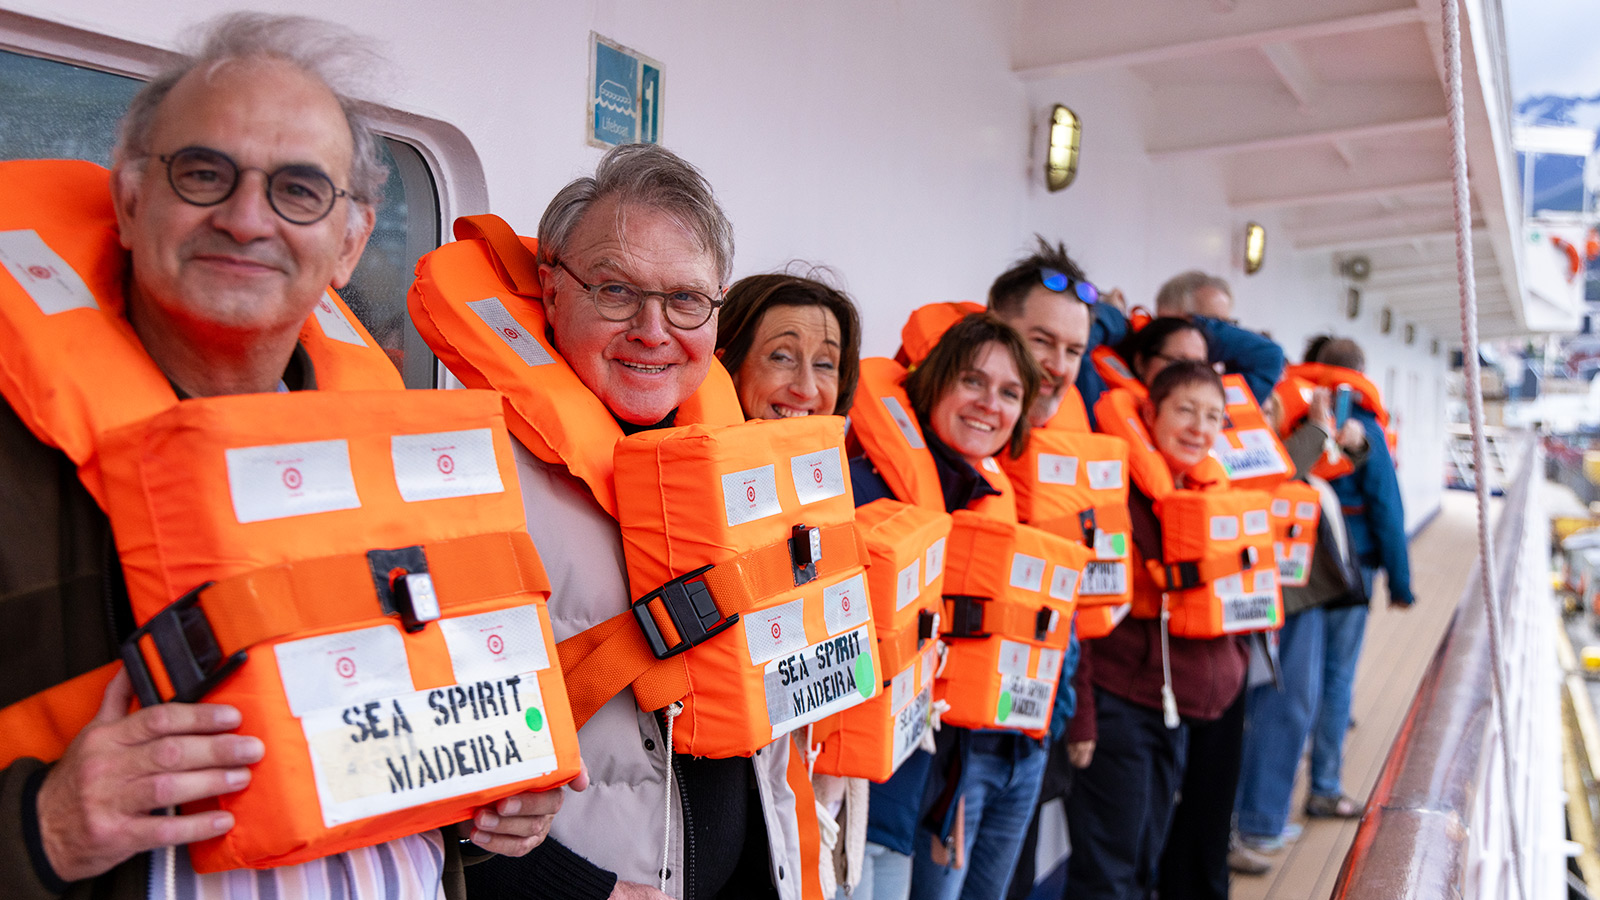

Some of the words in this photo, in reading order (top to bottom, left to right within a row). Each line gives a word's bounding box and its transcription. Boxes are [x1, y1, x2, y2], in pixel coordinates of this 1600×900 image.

[778, 653, 809, 687] SEA
[815, 630, 861, 670] SPIRIT
[342, 699, 413, 744] SEA
[427, 675, 522, 727] SPIRIT
[793, 666, 857, 717] MADEIRA
[386, 730, 523, 794] MADEIRA
